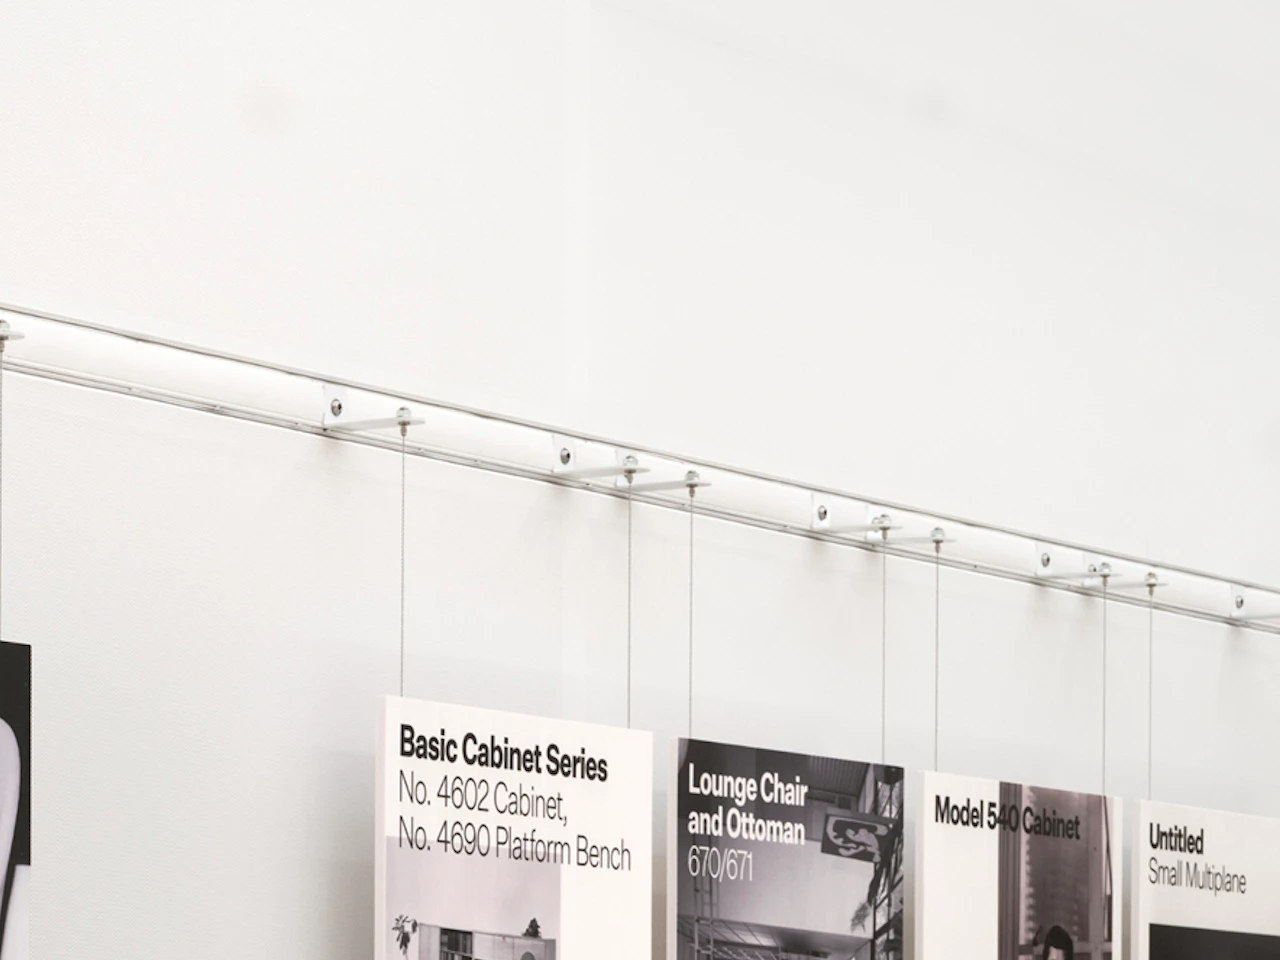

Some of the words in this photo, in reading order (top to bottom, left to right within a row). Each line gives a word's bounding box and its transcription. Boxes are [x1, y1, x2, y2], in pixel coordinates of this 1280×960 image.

[400, 724, 458, 763] Basic
[462, 732, 542, 774] Cabinet
[546, 744, 608, 782] Series
[399, 769, 431, 806] No.
[437, 775, 489, 812] 4602
[494, 781, 568, 827] Cabinet,
[688, 763, 758, 807] Lounge
[760, 772, 809, 807] Chair
[688, 806, 723, 837] and
[726, 807, 805, 845] Ottoman
[935, 795, 984, 828] Model
[987, 802, 1019, 833] 540
[1022, 806, 1080, 840] Cabinet
[1149, 822, 1204, 855] Untitled
[399, 815, 431, 851] No.
[437, 820, 490, 857] 4690
[496, 826, 571, 865] Platform
[576, 834, 631, 871] Bench
[688, 845, 753, 882] 670/671
[1148, 857, 1182, 886] Small
[1186, 861, 1247, 897] Multiplane
